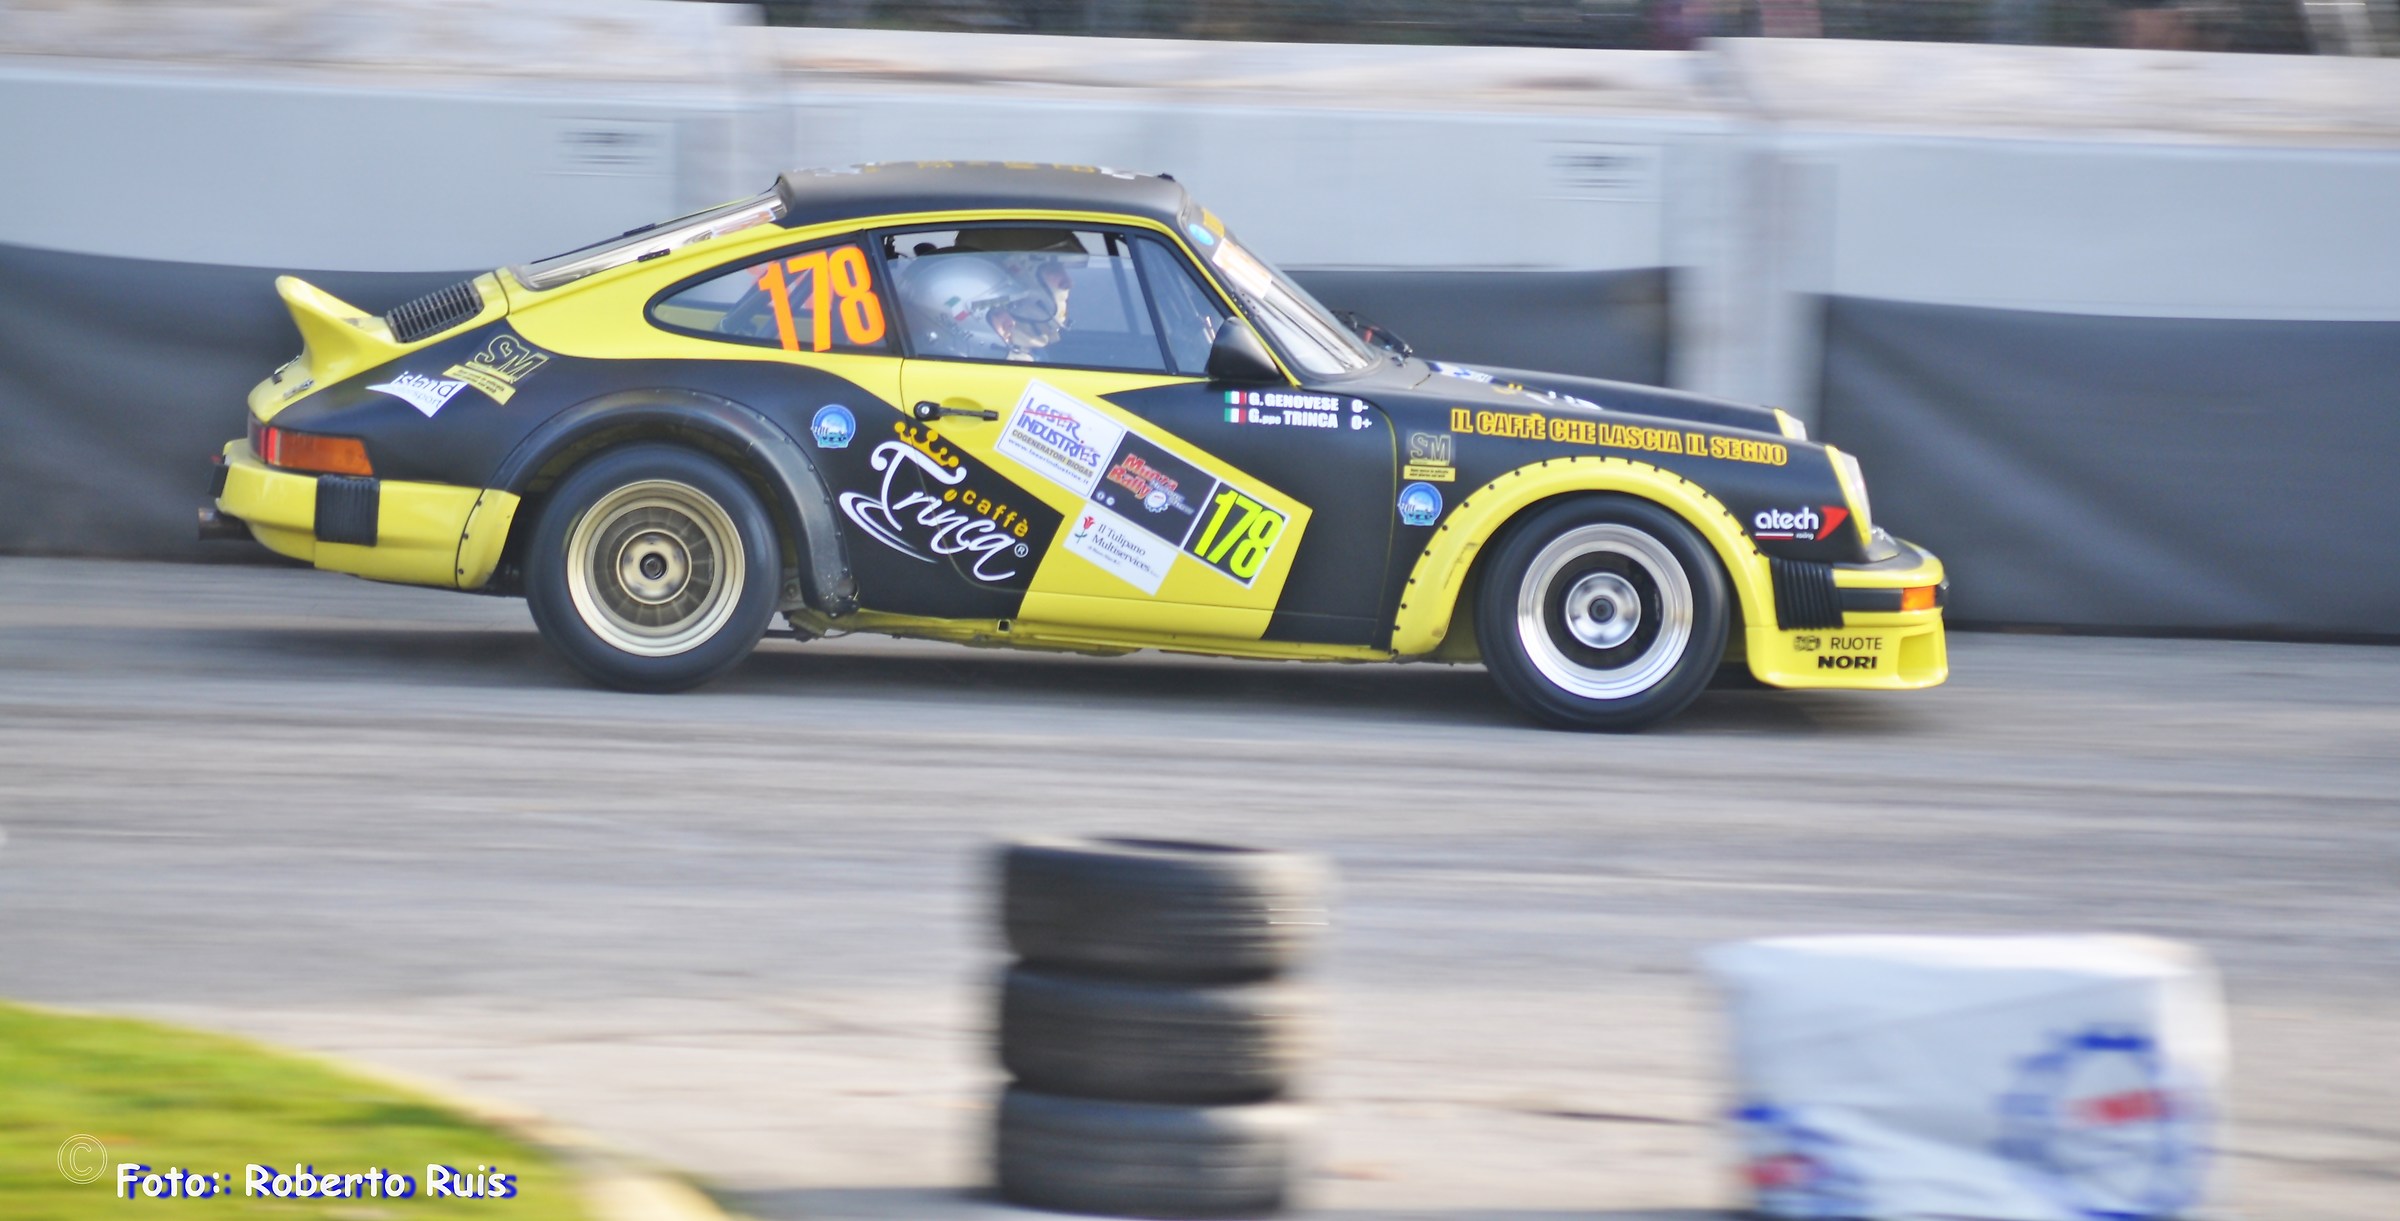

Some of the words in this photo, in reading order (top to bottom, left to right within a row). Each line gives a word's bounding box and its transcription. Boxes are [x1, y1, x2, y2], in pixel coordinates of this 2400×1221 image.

[758, 245, 886, 352] 178
[1024, 397, 1081, 441] LASER
[1265, 393, 1340, 411] GENOVESE
[1283, 410, 1339, 428] TRINCA
[1012, 429, 1067, 465] COGENERATORI
[1066, 457, 1095, 479] BIOGAS
[1017, 413, 1101, 467] INDUSTRIES
[1451, 408, 1473, 433] IL
[1476, 411, 1546, 440] CAFFÈ
[1550, 418, 1596, 445] CHE
[1599, 423, 1683, 454] LASCIA
[1686, 433, 1708, 456] IL
[1710, 435, 1788, 466] SEGNO
[1106, 464, 1153, 500] Rally
[868, 441, 1016, 581] Trinca
[962, 489, 1029, 538] caffè
[1754, 506, 1820, 530] atech
[1092, 534, 1150, 573] Multiservices
[1107, 527, 1146, 556] Tulipano
[1195, 489, 1285, 578] 178
[1817, 656, 1878, 669] NORI
[1830, 637, 1883, 650] RUOTE
